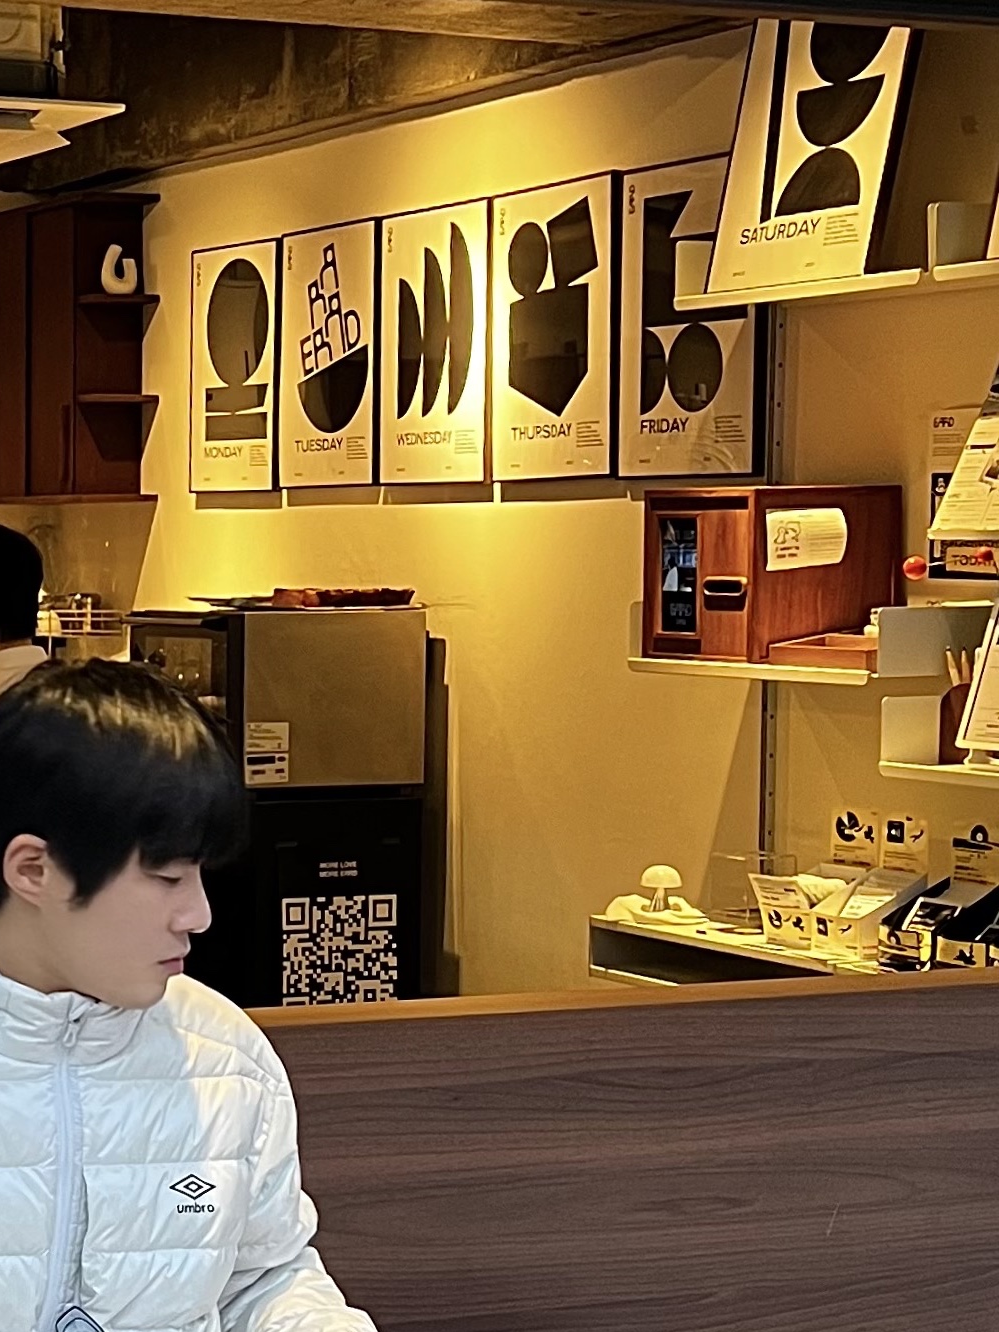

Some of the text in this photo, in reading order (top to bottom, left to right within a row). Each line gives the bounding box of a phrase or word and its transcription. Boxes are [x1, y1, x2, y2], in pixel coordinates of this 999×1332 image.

[739, 217, 822, 245] SATURDAY
[511, 423, 572, 442] THURSDAY
[640, 417, 690, 434] FRIDAY
[294, 437, 344, 452] TUESDAY
[396, 430, 452, 446] WEDNESDAY
[203, 446, 243, 458] MONDAY
[177, 1201, 215, 1214] umbro
